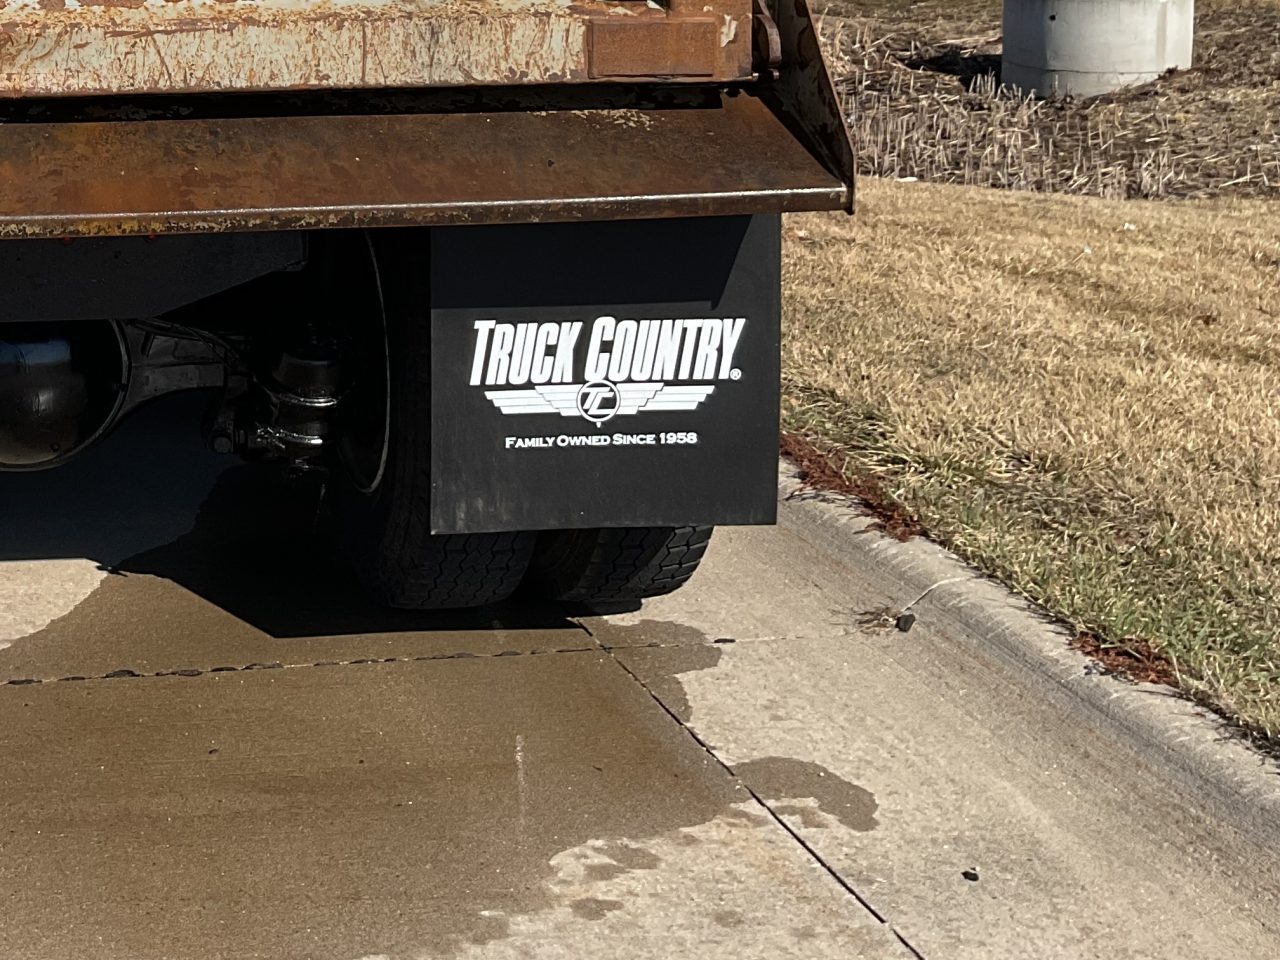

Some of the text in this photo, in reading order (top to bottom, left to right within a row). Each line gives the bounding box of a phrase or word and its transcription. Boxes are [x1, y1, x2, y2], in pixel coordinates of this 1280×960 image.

[469, 320, 583, 386] TRUCK
[506, 432, 698, 449] FAMILY OWNED SINCE 1958
